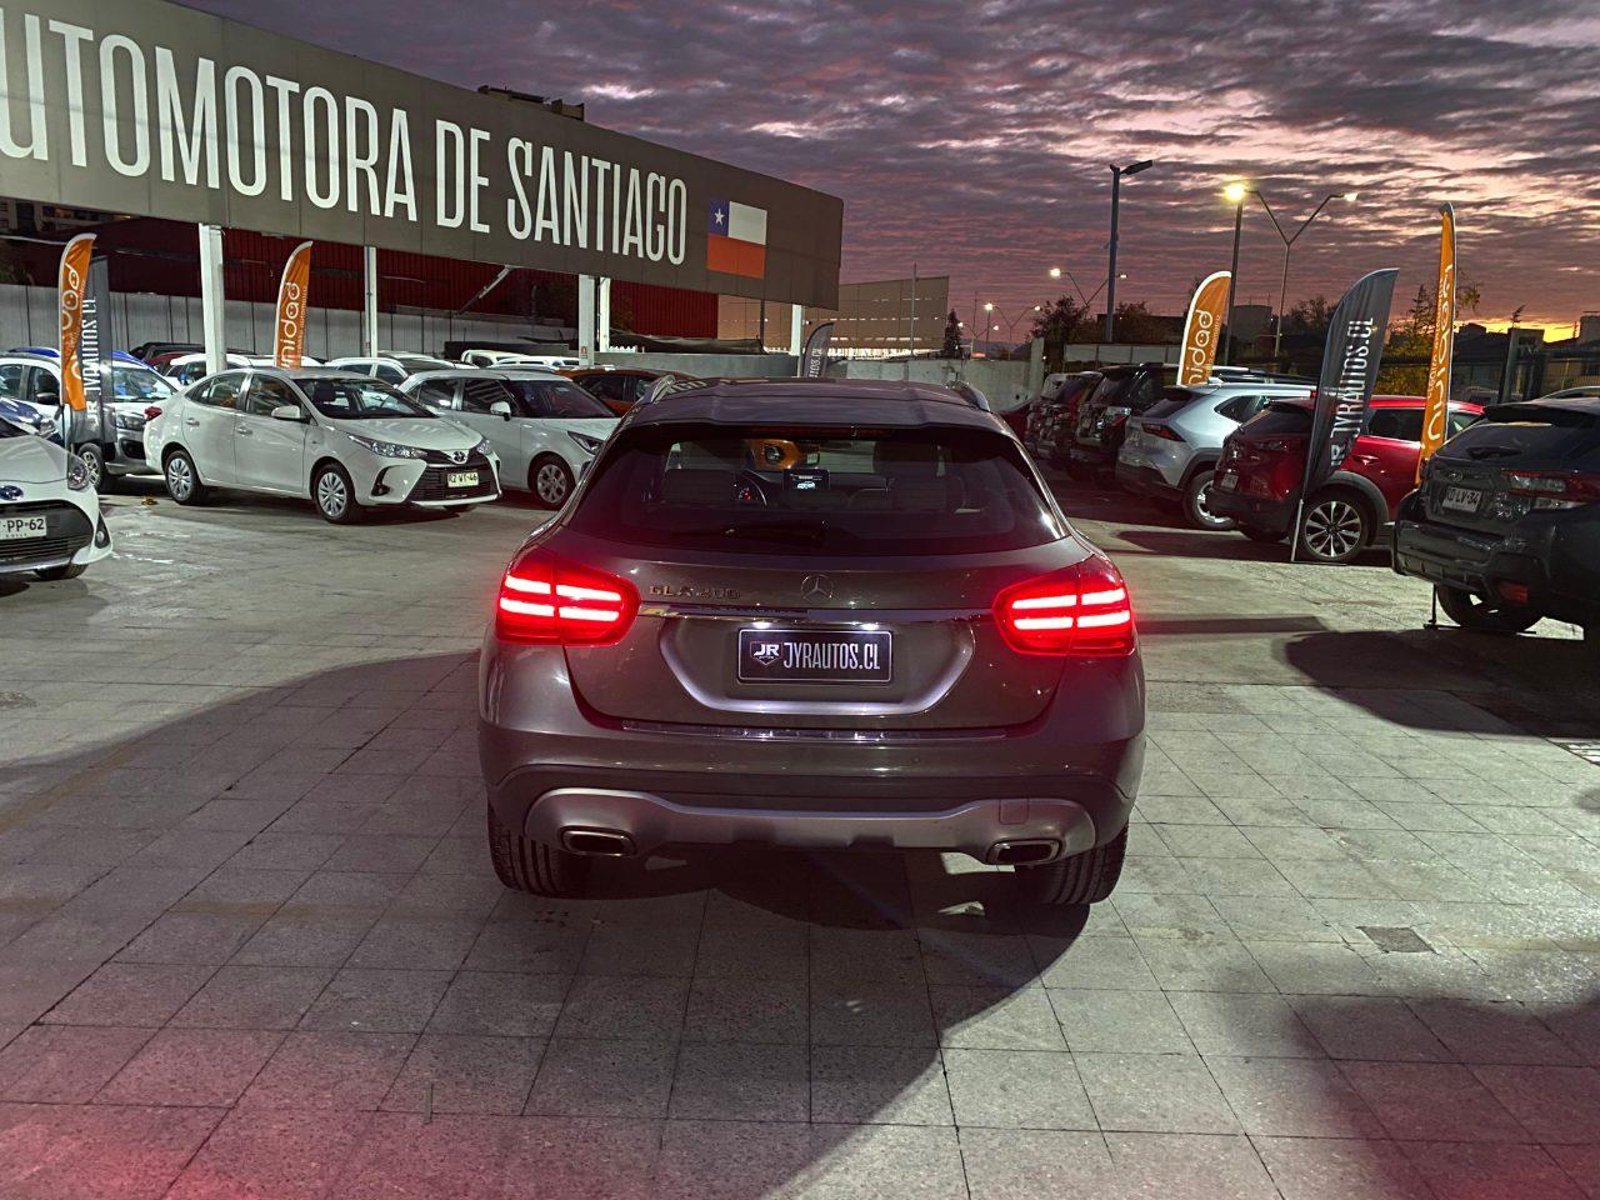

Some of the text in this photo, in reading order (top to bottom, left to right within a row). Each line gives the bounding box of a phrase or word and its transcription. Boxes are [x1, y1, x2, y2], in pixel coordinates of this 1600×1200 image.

[435, 119, 491, 234] DE
[506, 136, 688, 266] SANTIAGO
[752, 641, 881, 670] JR JYRAUTOS.CL
